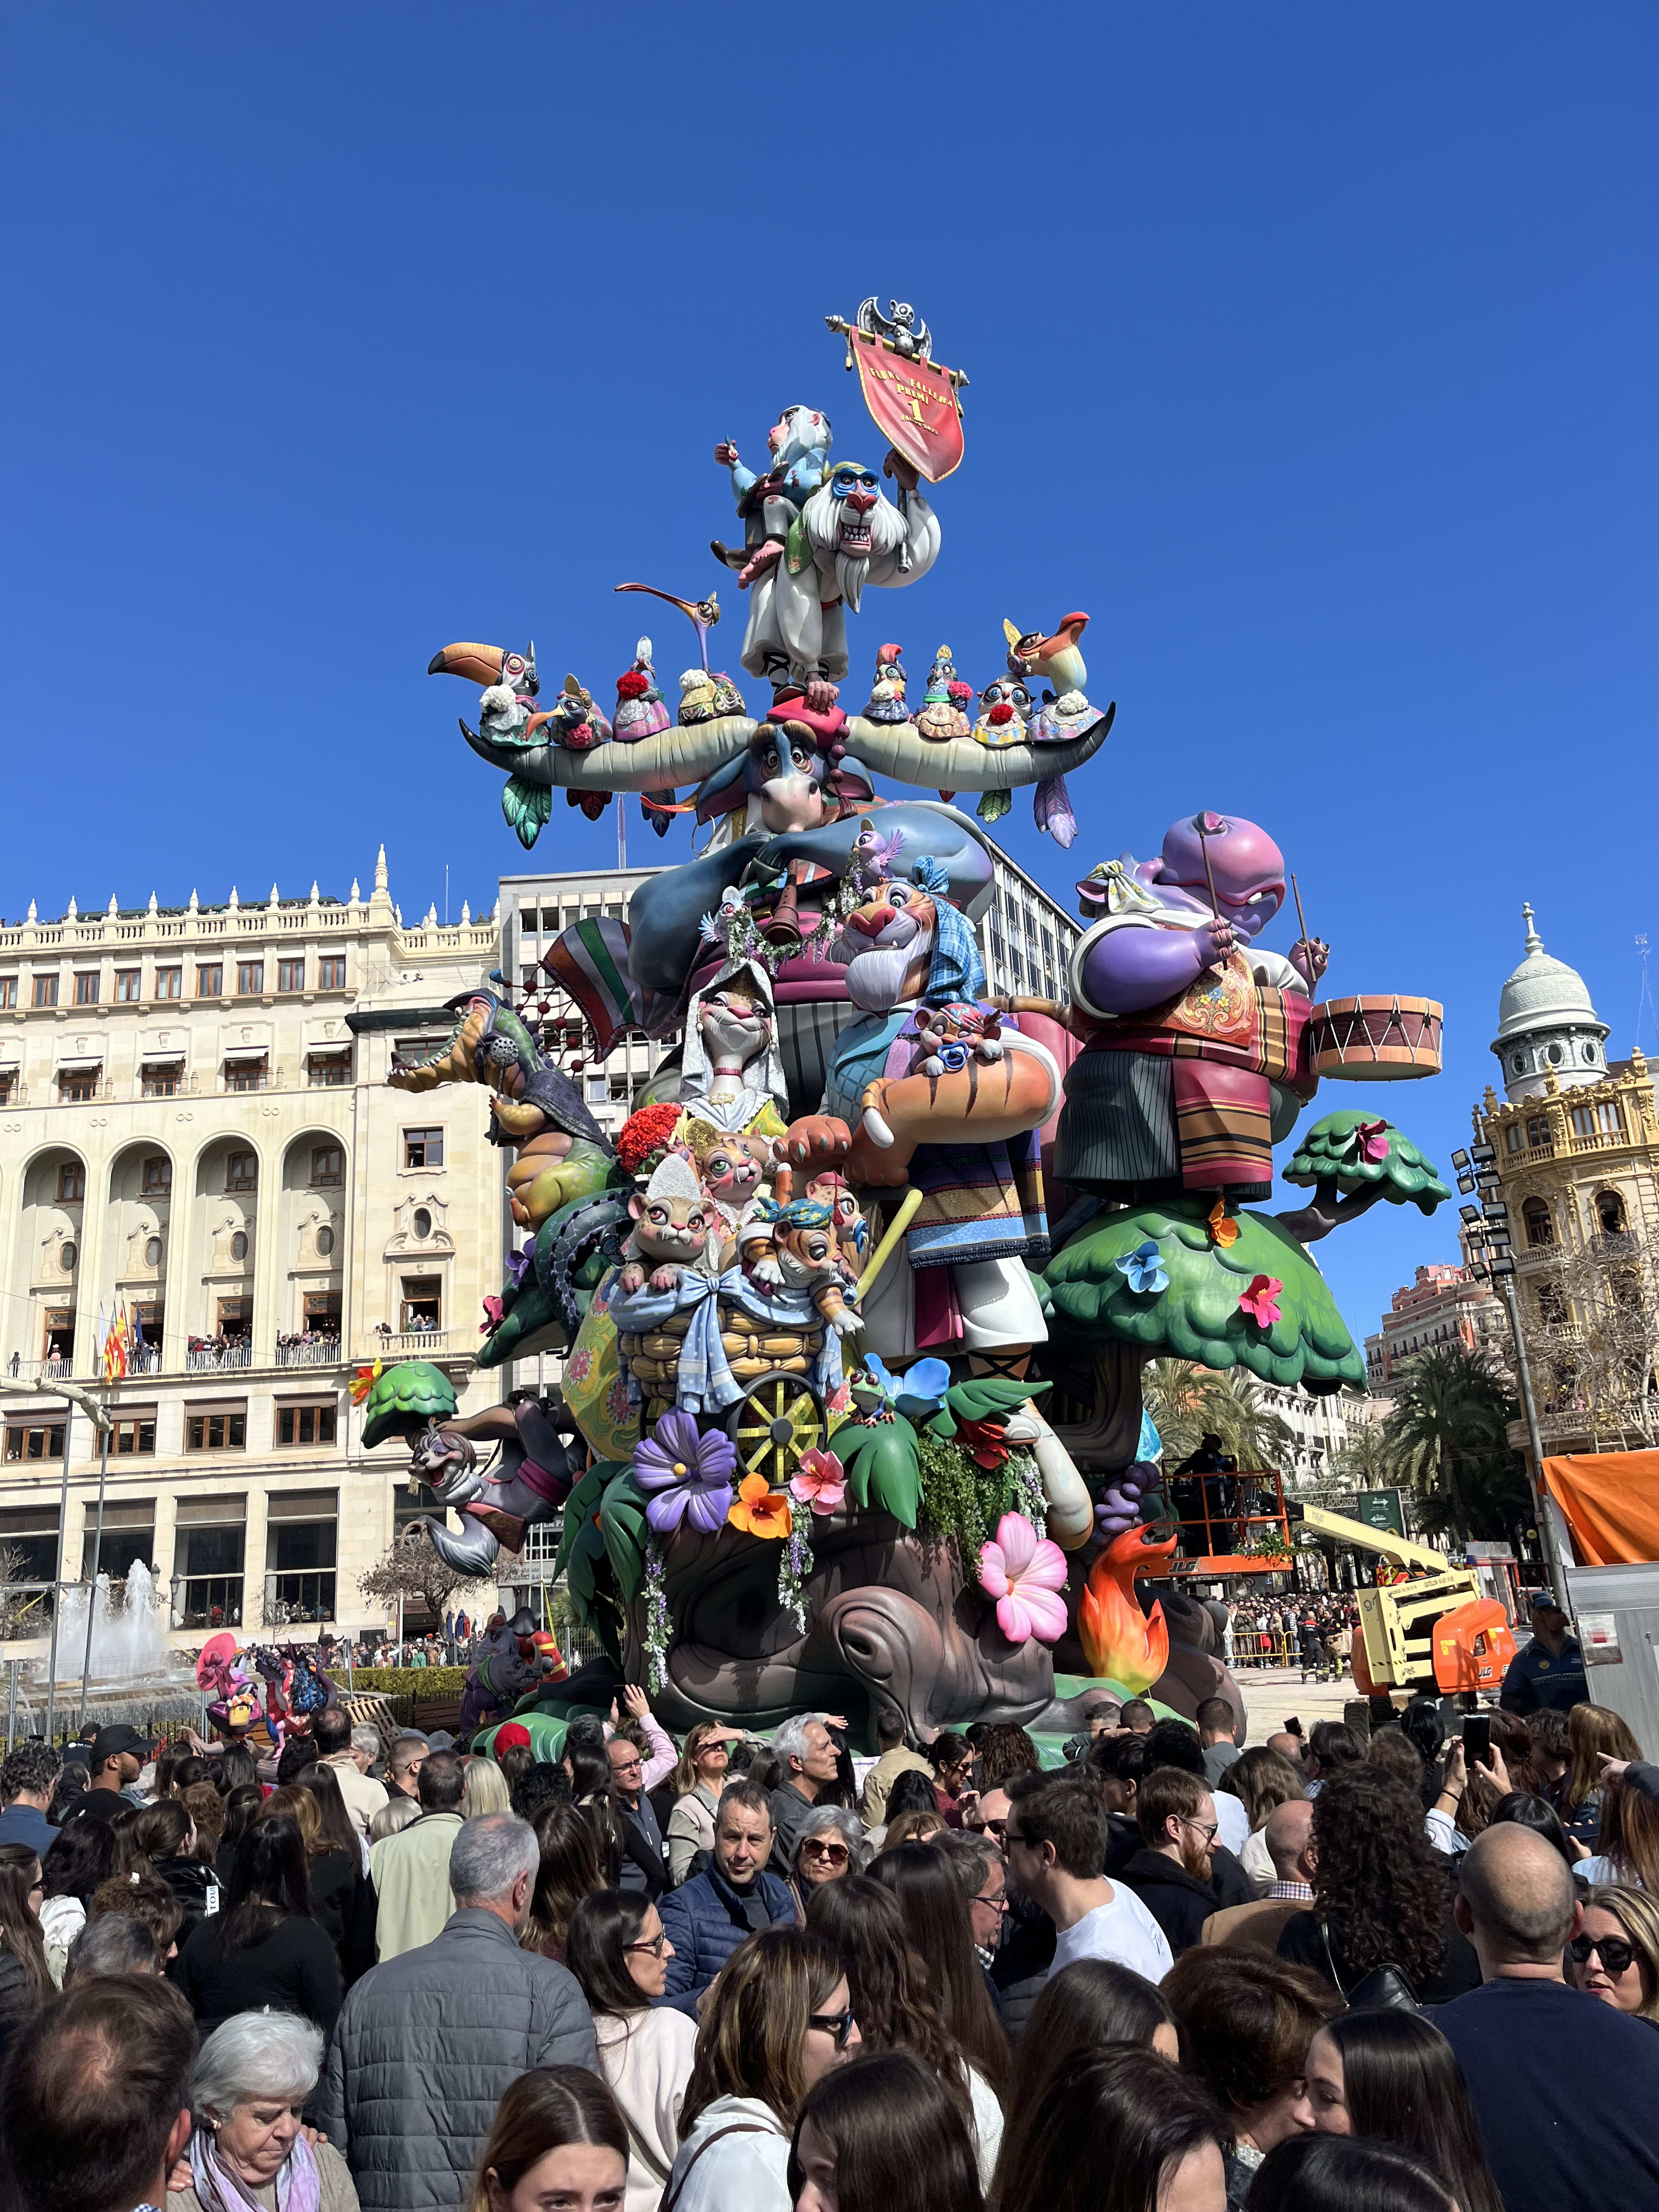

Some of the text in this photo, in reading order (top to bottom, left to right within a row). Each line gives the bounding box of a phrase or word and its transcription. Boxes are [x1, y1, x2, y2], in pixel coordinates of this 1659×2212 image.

[896, 383, 929, 405] PREMI
[908, 399, 924, 423] 1
[1168, 1561, 1197, 1573] JLG
[1478, 1667, 1492, 1677] JLG
